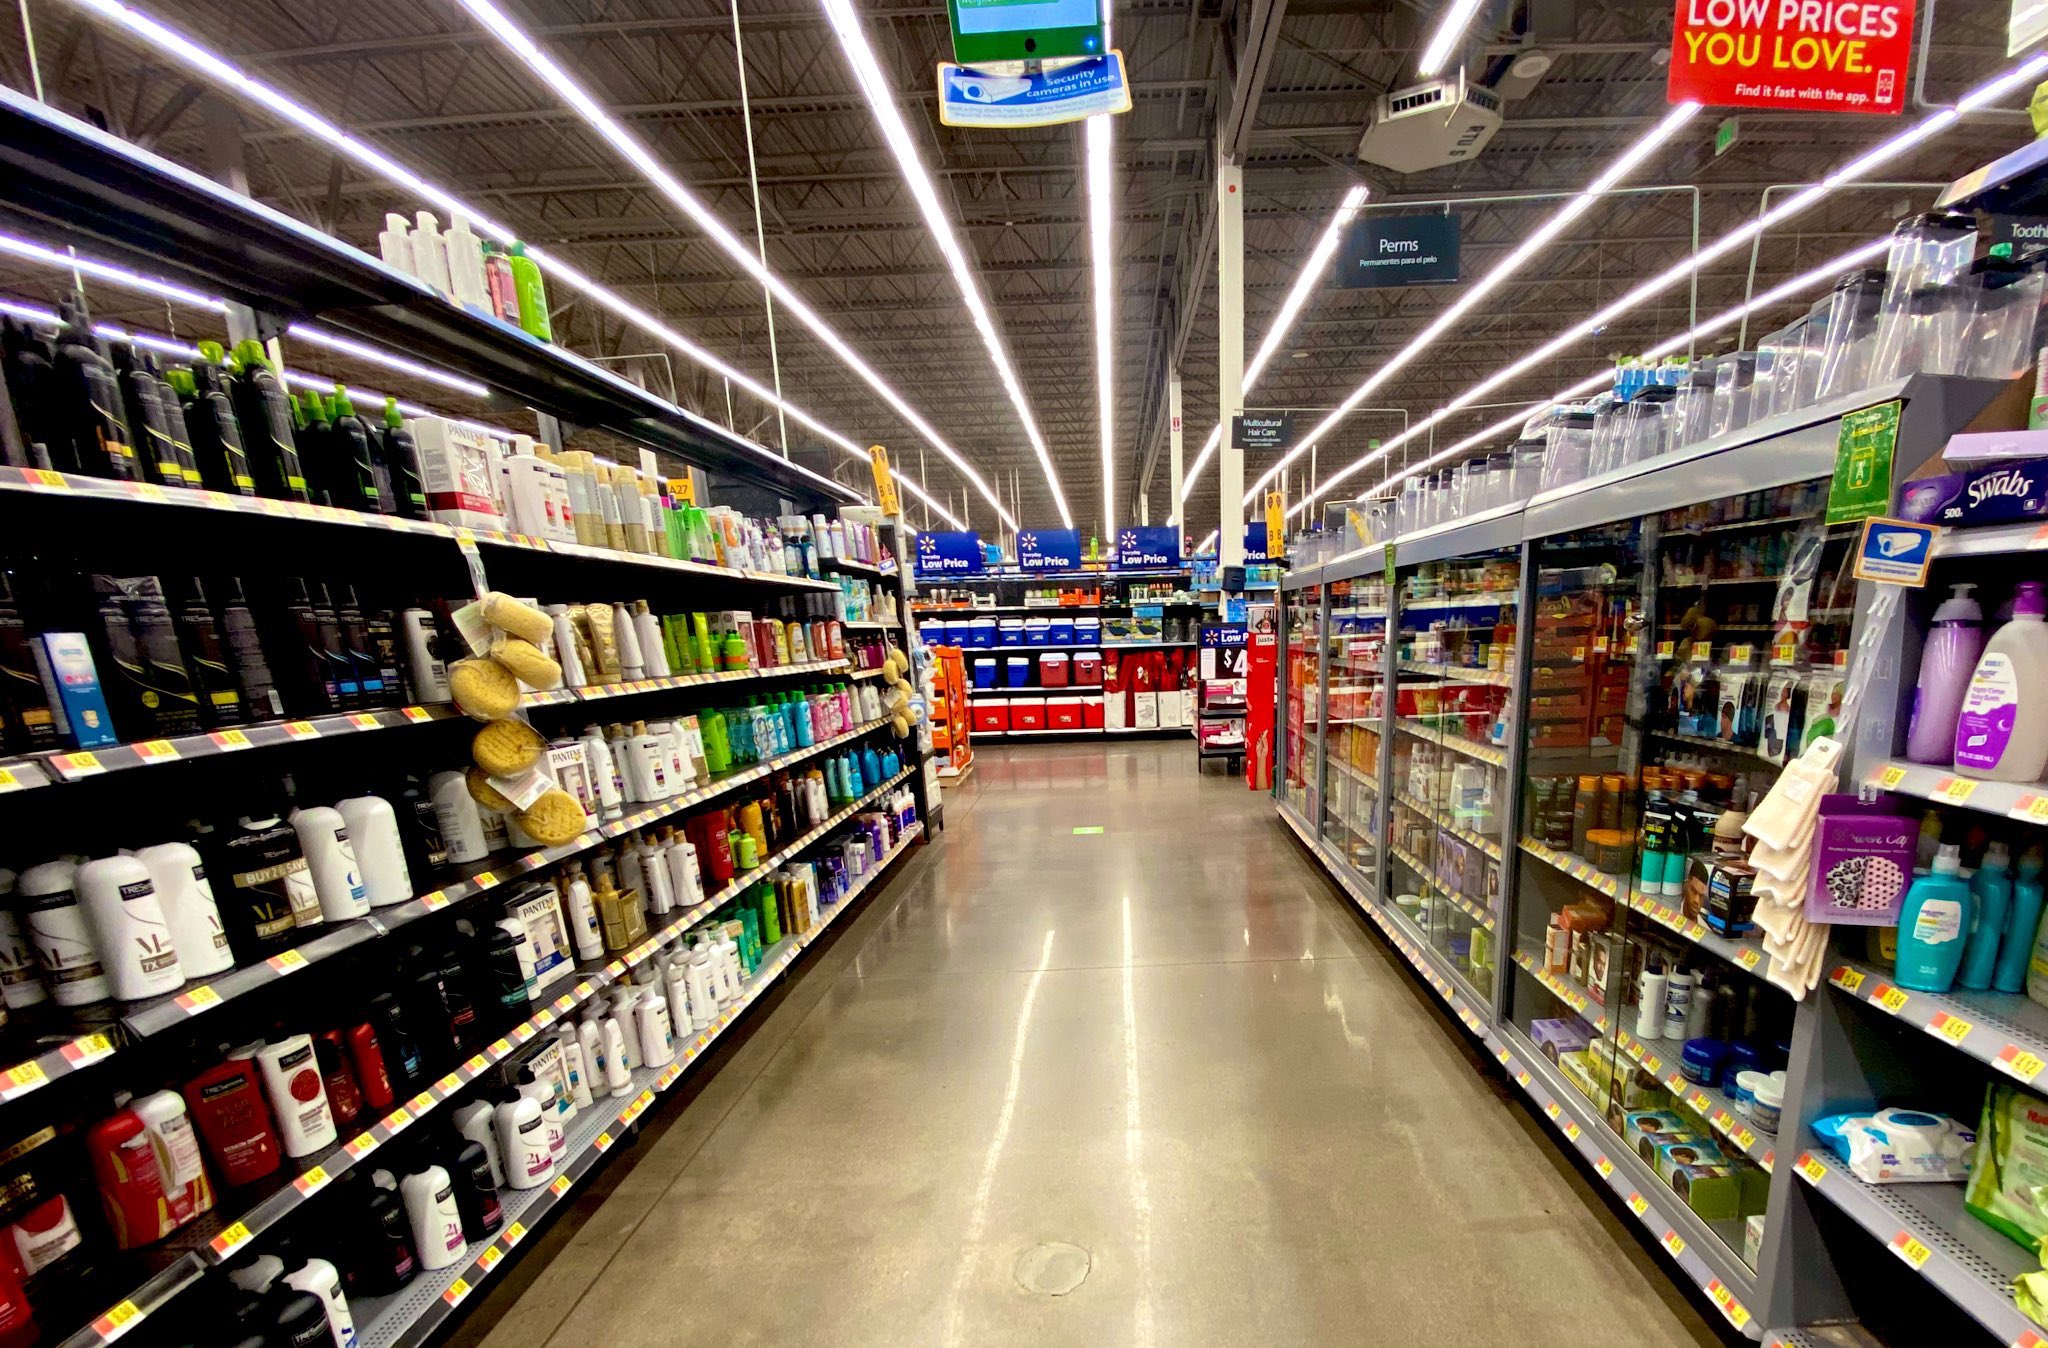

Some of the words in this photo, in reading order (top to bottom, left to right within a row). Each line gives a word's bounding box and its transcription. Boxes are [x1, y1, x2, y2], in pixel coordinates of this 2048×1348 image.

[1688, 0, 1769, 29] LOW
[1777, 0, 1899, 38] PRICES
[1684, 31, 1761, 67] YOU
[1773, 36, 1873, 74] LOVE.
[1046, 68, 1095, 87] Security
[1026, 83, 1077, 98] cameras
[1079, 79, 1092, 90] in
[1093, 74, 1119, 86] use.
[1735, 83, 1760, 96] Find
[1763, 85, 1772, 97] it
[1774, 85, 1796, 98] fast
[1798, 87, 1822, 100] with
[1825, 88, 1843, 101] the
[1845, 92, 1869, 105] app.
[2011, 223, 2048, 238] Tooth
[1380, 239, 1419, 253] Perms
[1360, 258, 1400, 268] Permanentes
[1401, 257, 1415, 266] para
[1416, 256, 1422, 264] el
[1423, 255, 1437, 264] pelo
[1243, 419, 1282, 427] Multicultural
[1261, 429, 1276, 437] Care
[669, 484, 688, 496] A27
[1968, 470, 2034, 508] Swabs
[922, 559, 943, 569] Low
[944, 558, 969, 568] Price
[1023, 557, 1042, 567] Low
[1044, 556, 1070, 566] Price
[1122, 554, 1142, 565] Low
[1144, 553, 1168, 564] Price
[1221, 633, 1242, 643] Low
[247, 872, 271, 885] BUY
[272, 869, 279, 879] 2
[287, 857, 308, 874] SAVE
[258, 924, 271, 935] 7X
[143, 960, 160, 971] 7X
